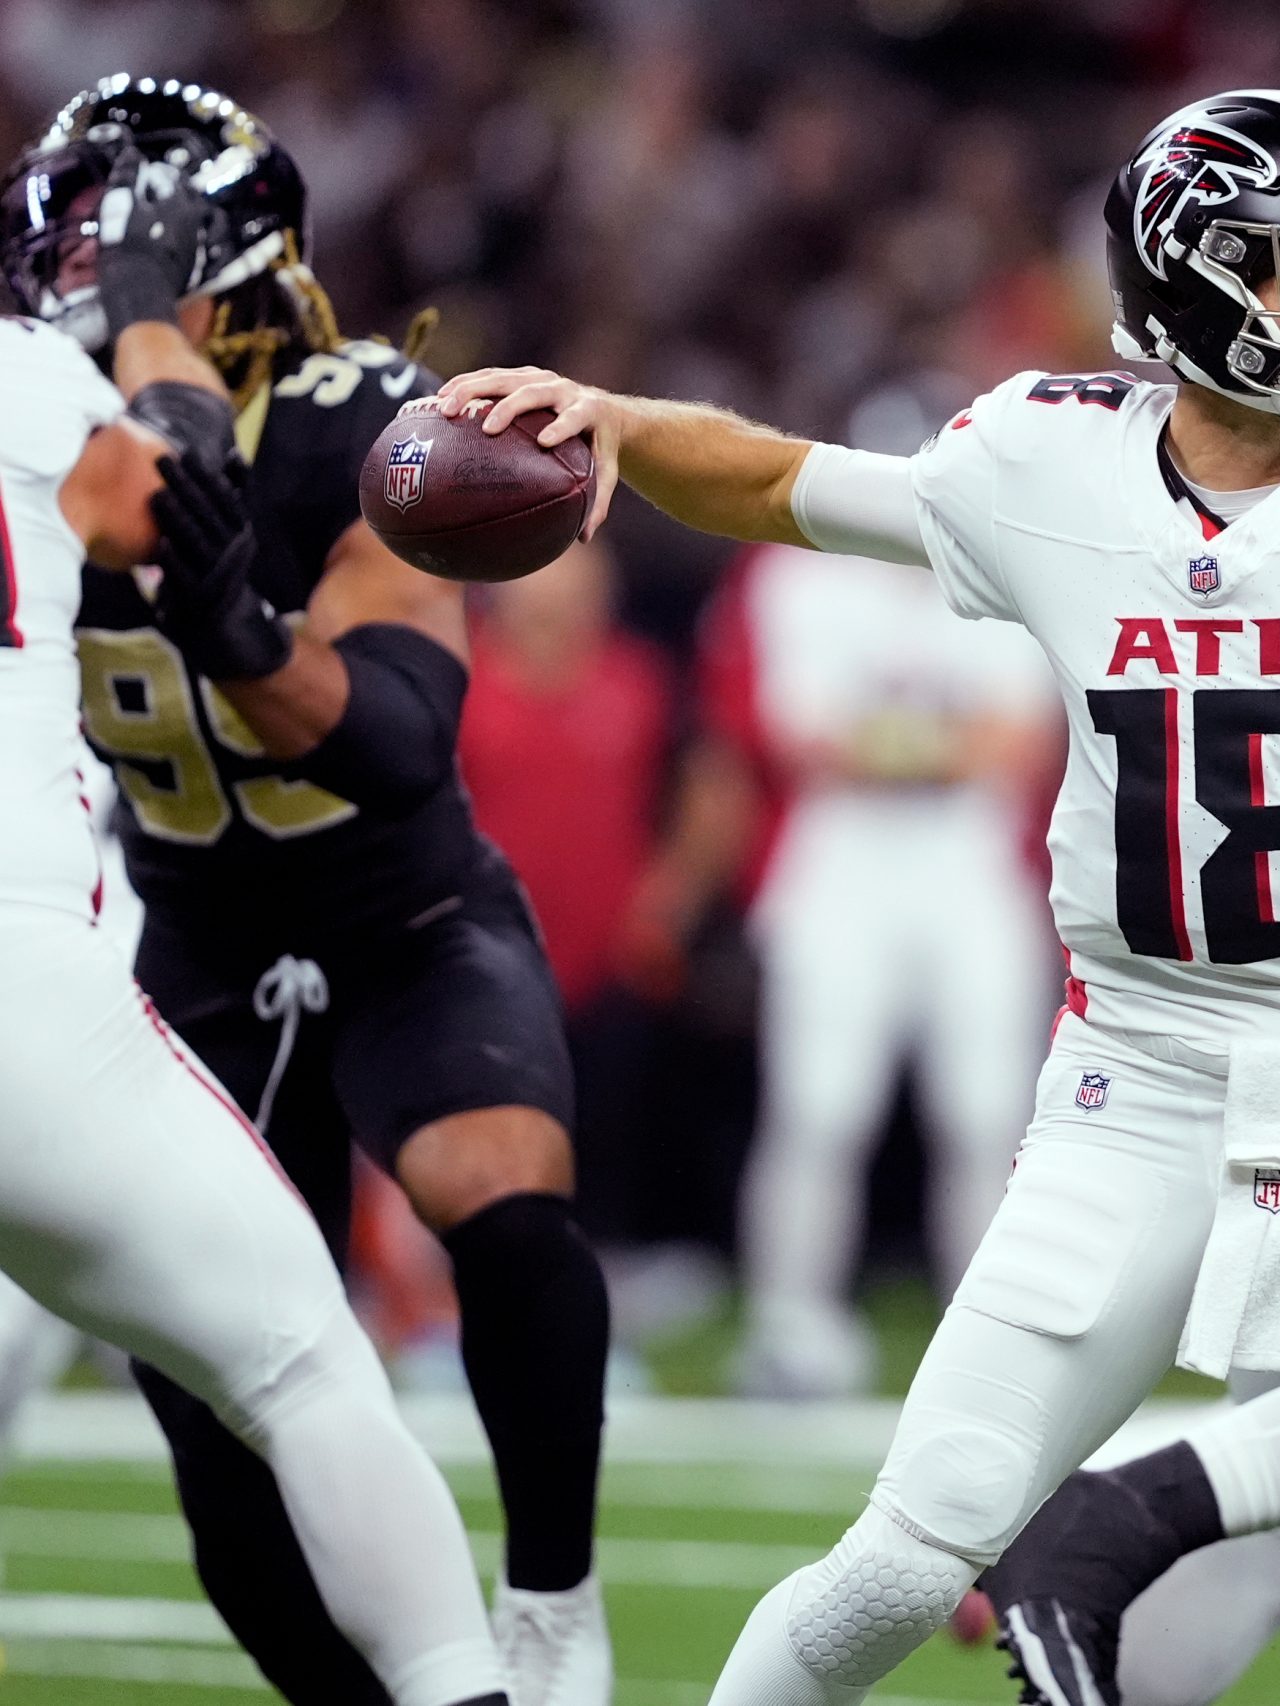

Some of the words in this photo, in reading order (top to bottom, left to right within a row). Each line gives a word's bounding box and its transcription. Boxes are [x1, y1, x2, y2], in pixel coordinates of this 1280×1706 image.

[387, 466, 418, 499] NFL
[1192, 571, 1216, 590] NFL
[1079, 1086, 1102, 1105] NFL
